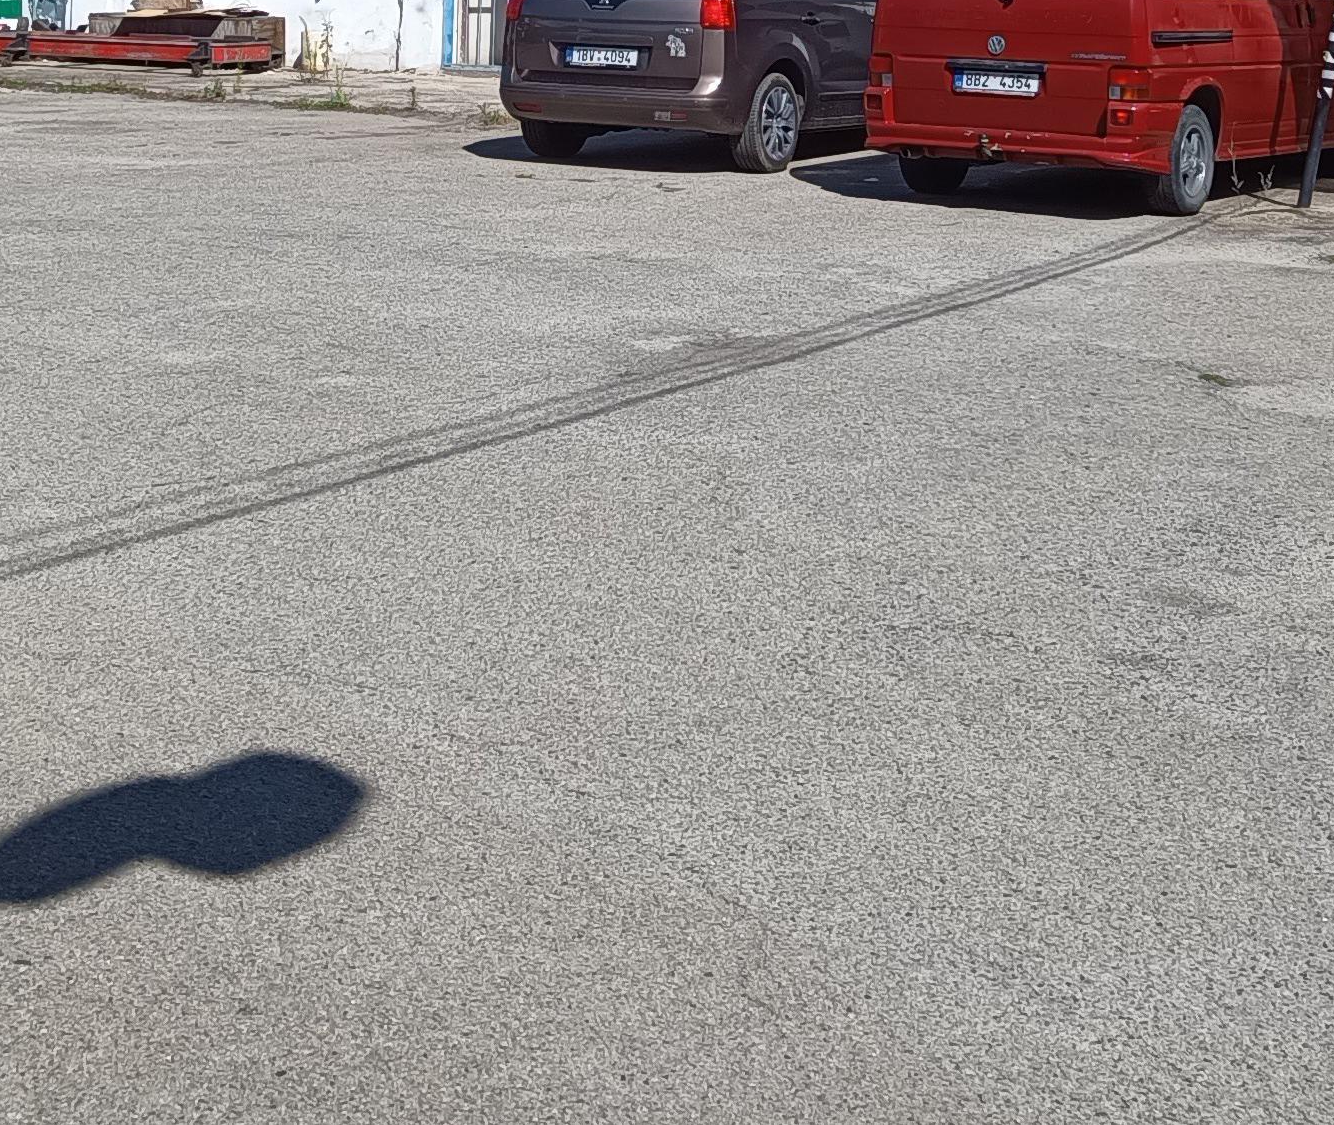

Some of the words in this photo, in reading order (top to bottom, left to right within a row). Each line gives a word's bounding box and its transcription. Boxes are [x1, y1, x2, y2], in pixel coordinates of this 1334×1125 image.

[577, 49, 595, 62] 1BV
[604, 50, 631, 64] 4094
[999, 76, 1032, 90] 4354
